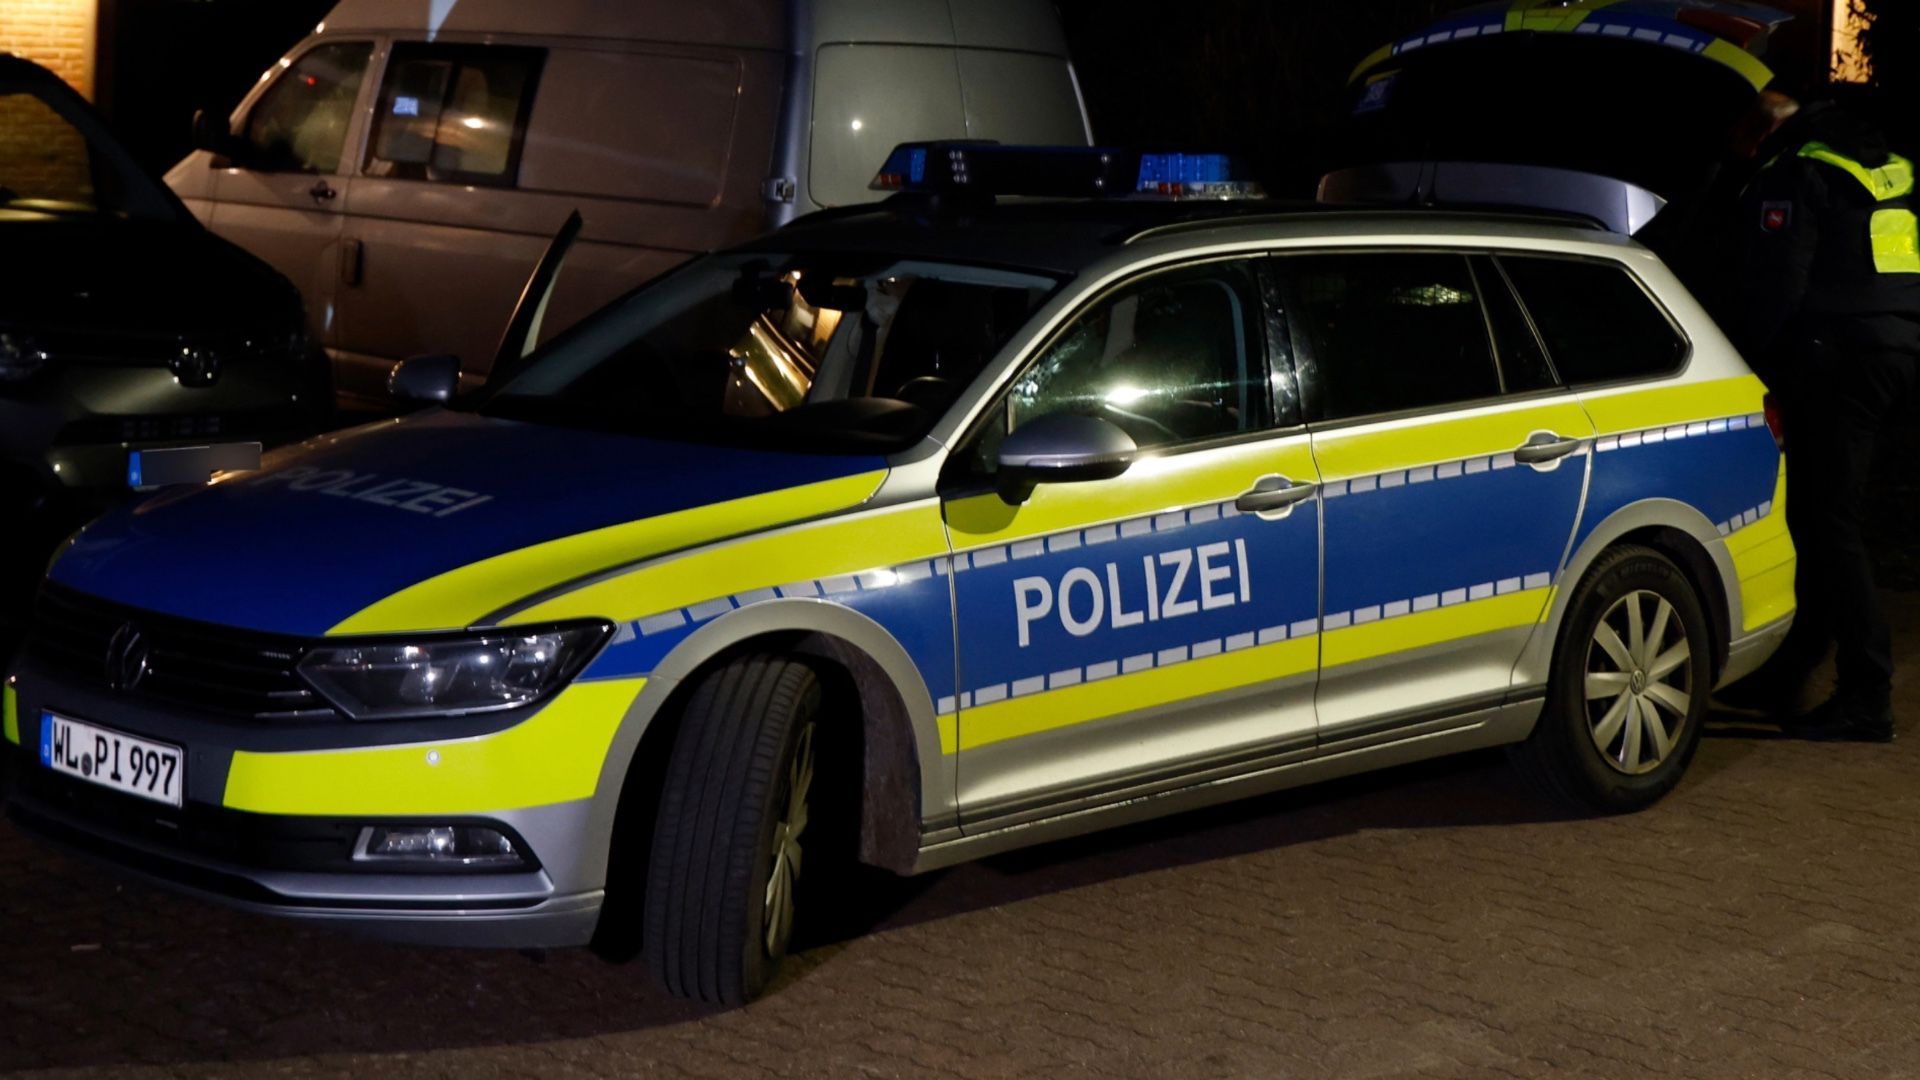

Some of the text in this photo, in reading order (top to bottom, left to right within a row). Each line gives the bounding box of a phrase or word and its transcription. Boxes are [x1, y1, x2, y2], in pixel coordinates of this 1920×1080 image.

[251, 466, 495, 517] POLIZEI
[1012, 538, 1251, 647] POLIZEI
[53, 722, 177, 795] WL PI 997
